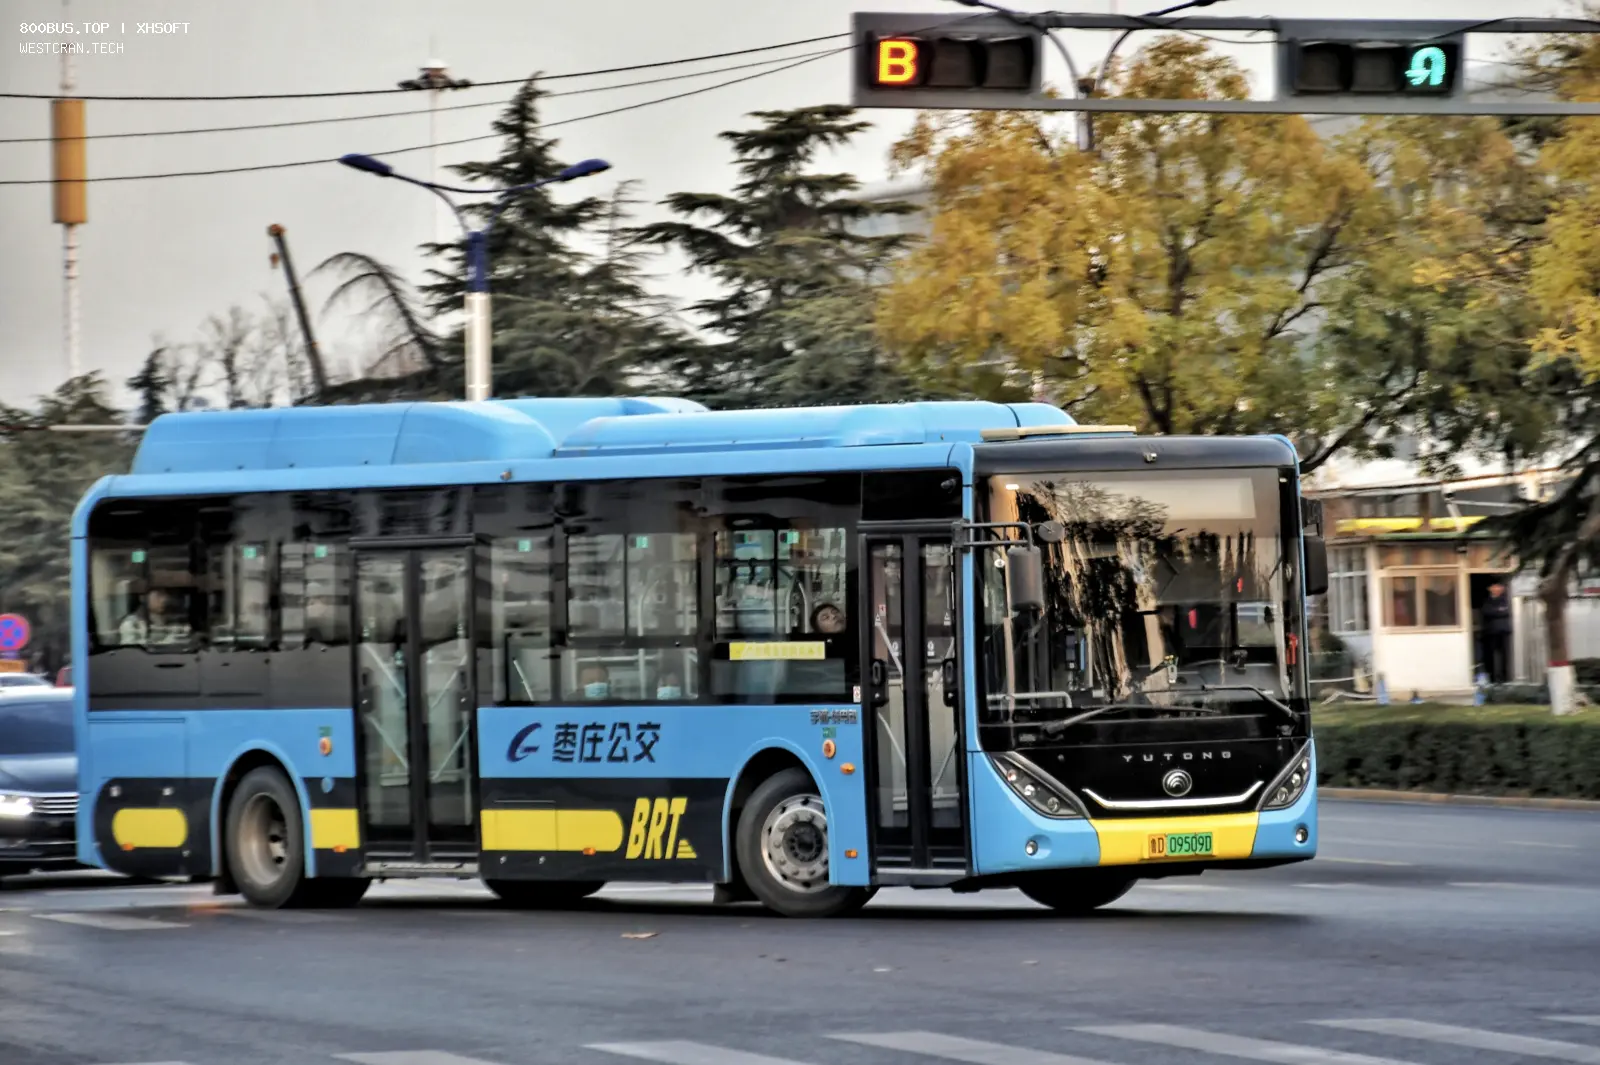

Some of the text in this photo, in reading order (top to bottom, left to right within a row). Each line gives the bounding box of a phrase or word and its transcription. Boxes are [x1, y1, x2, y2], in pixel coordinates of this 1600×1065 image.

[878, 40, 917, 82] B
[552, 721, 661, 764] 枣庄公交
[1122, 751, 1232, 763] YUTONG
[625, 797, 688, 860] BRT
